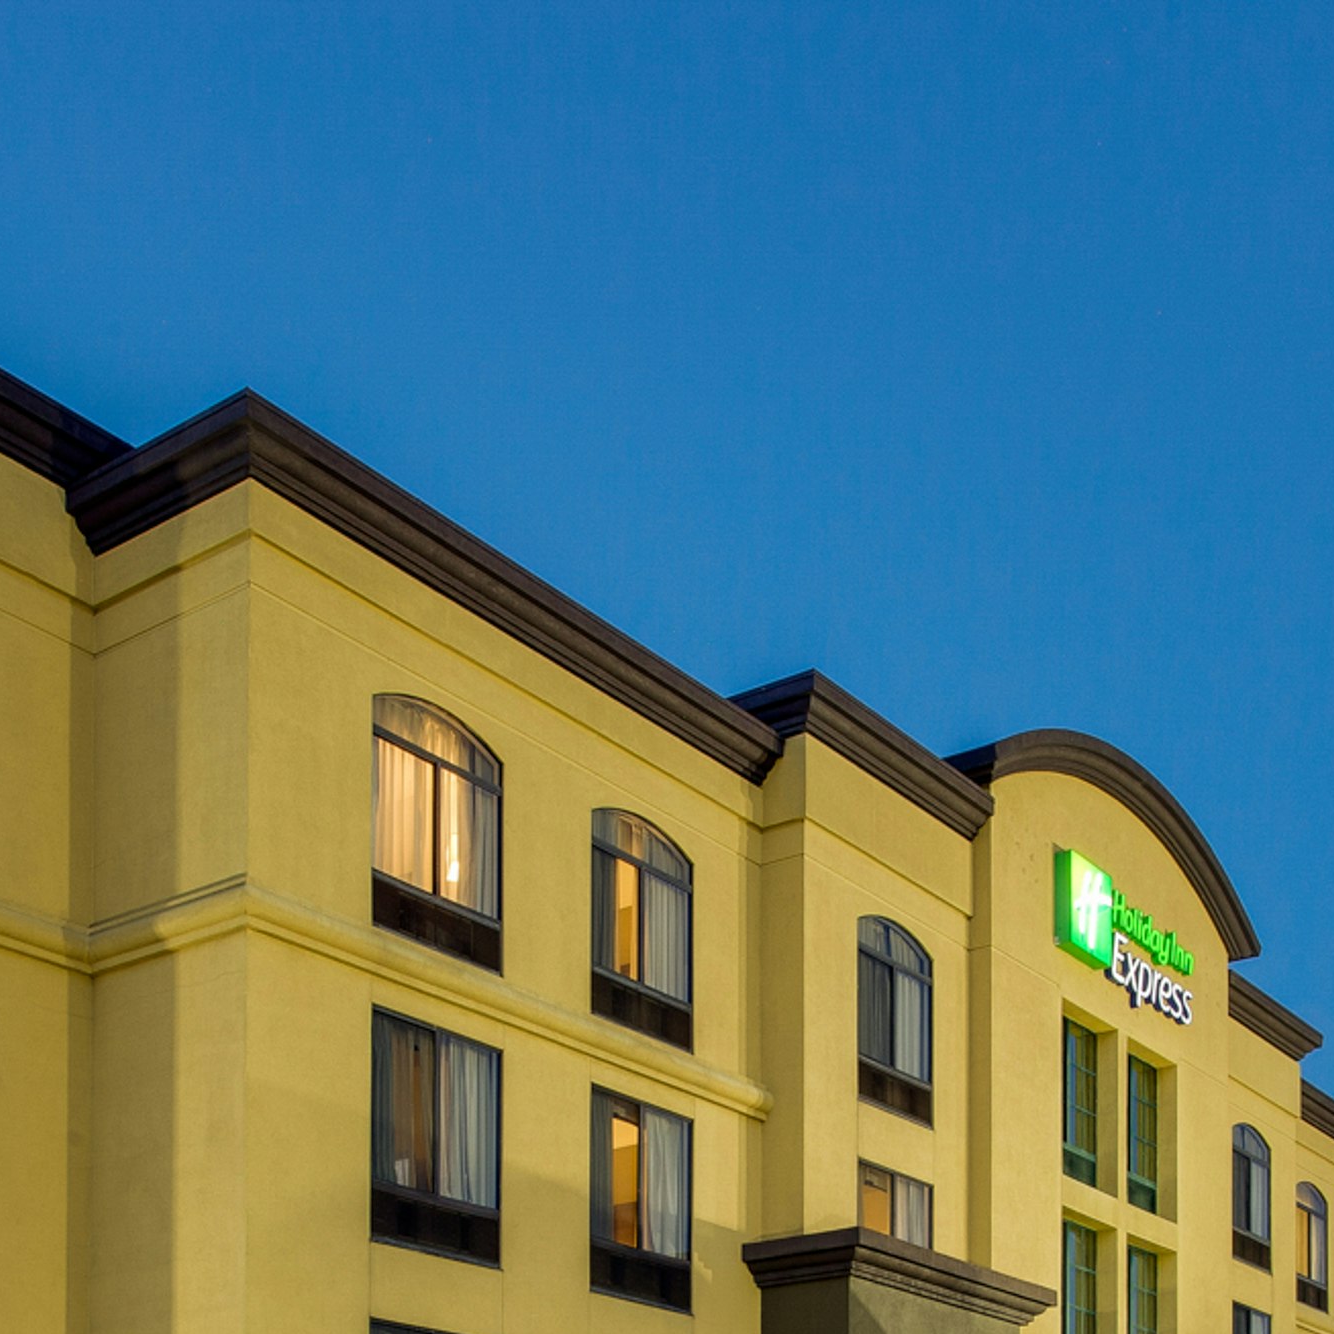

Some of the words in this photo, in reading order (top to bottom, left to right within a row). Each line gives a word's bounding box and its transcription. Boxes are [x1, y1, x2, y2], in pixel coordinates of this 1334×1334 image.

[1113, 889, 1170, 965] Holiday
[1169, 932, 1194, 976] Inn
[1111, 931, 1194, 1026] Express
